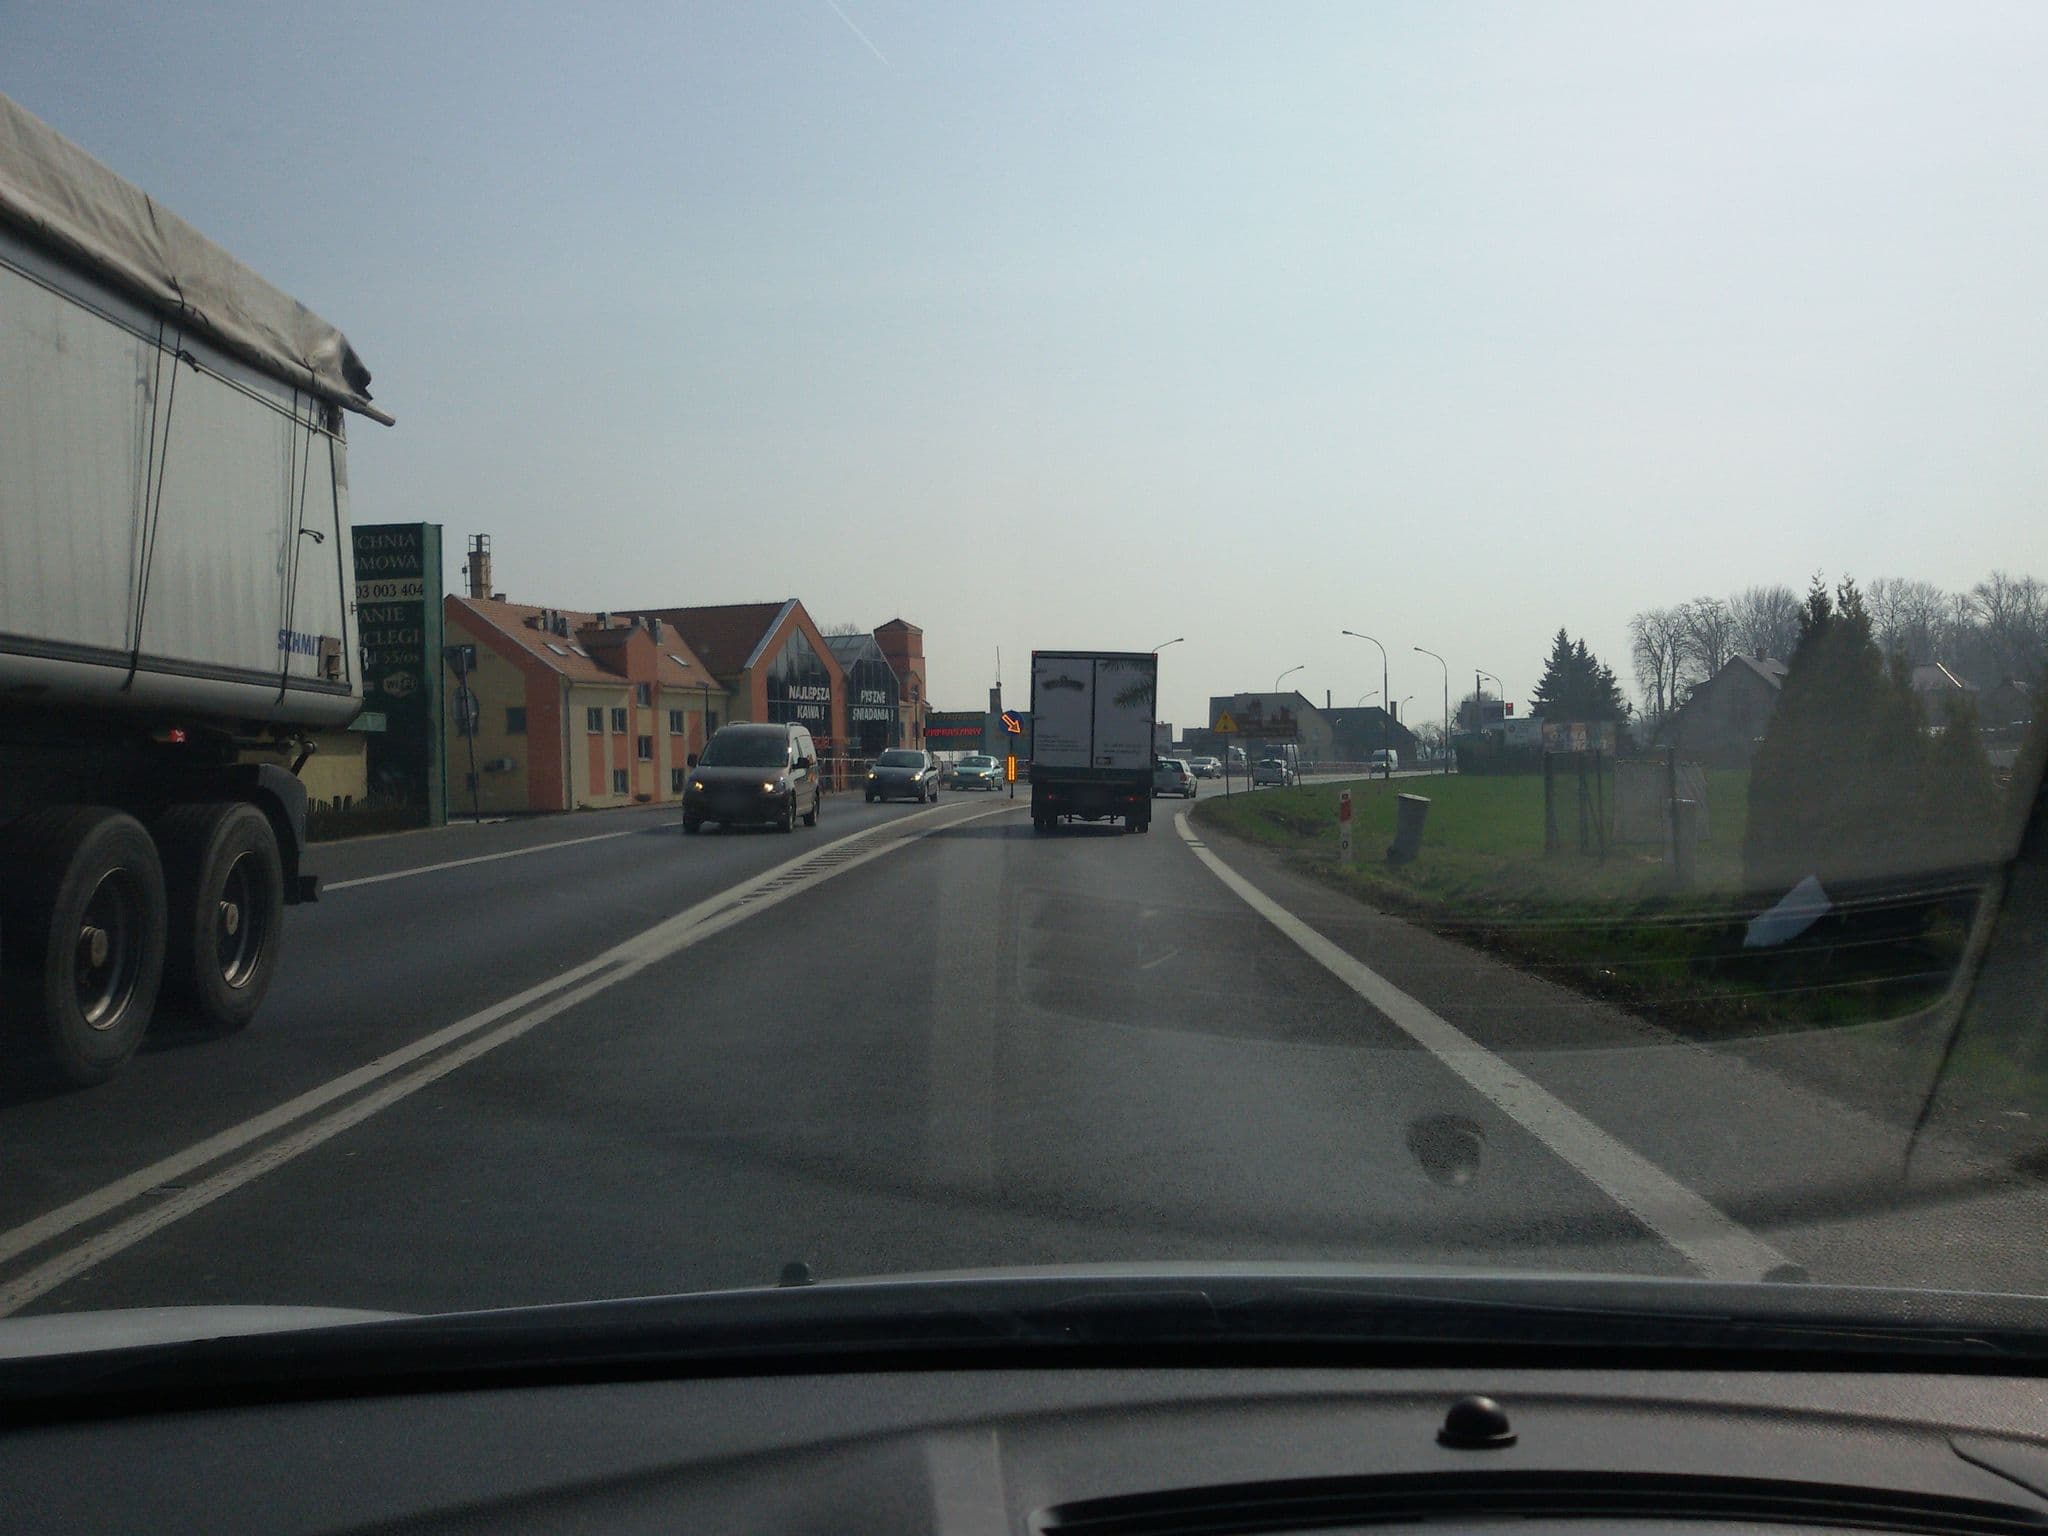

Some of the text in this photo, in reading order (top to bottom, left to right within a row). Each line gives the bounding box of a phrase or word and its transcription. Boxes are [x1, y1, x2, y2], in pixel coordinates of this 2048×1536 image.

[374, 584, 397, 598] 003
[401, 583, 424, 596] 404
[789, 685, 830, 701] NAJLEPSZA
[860, 690, 886, 704] PYSZNE
